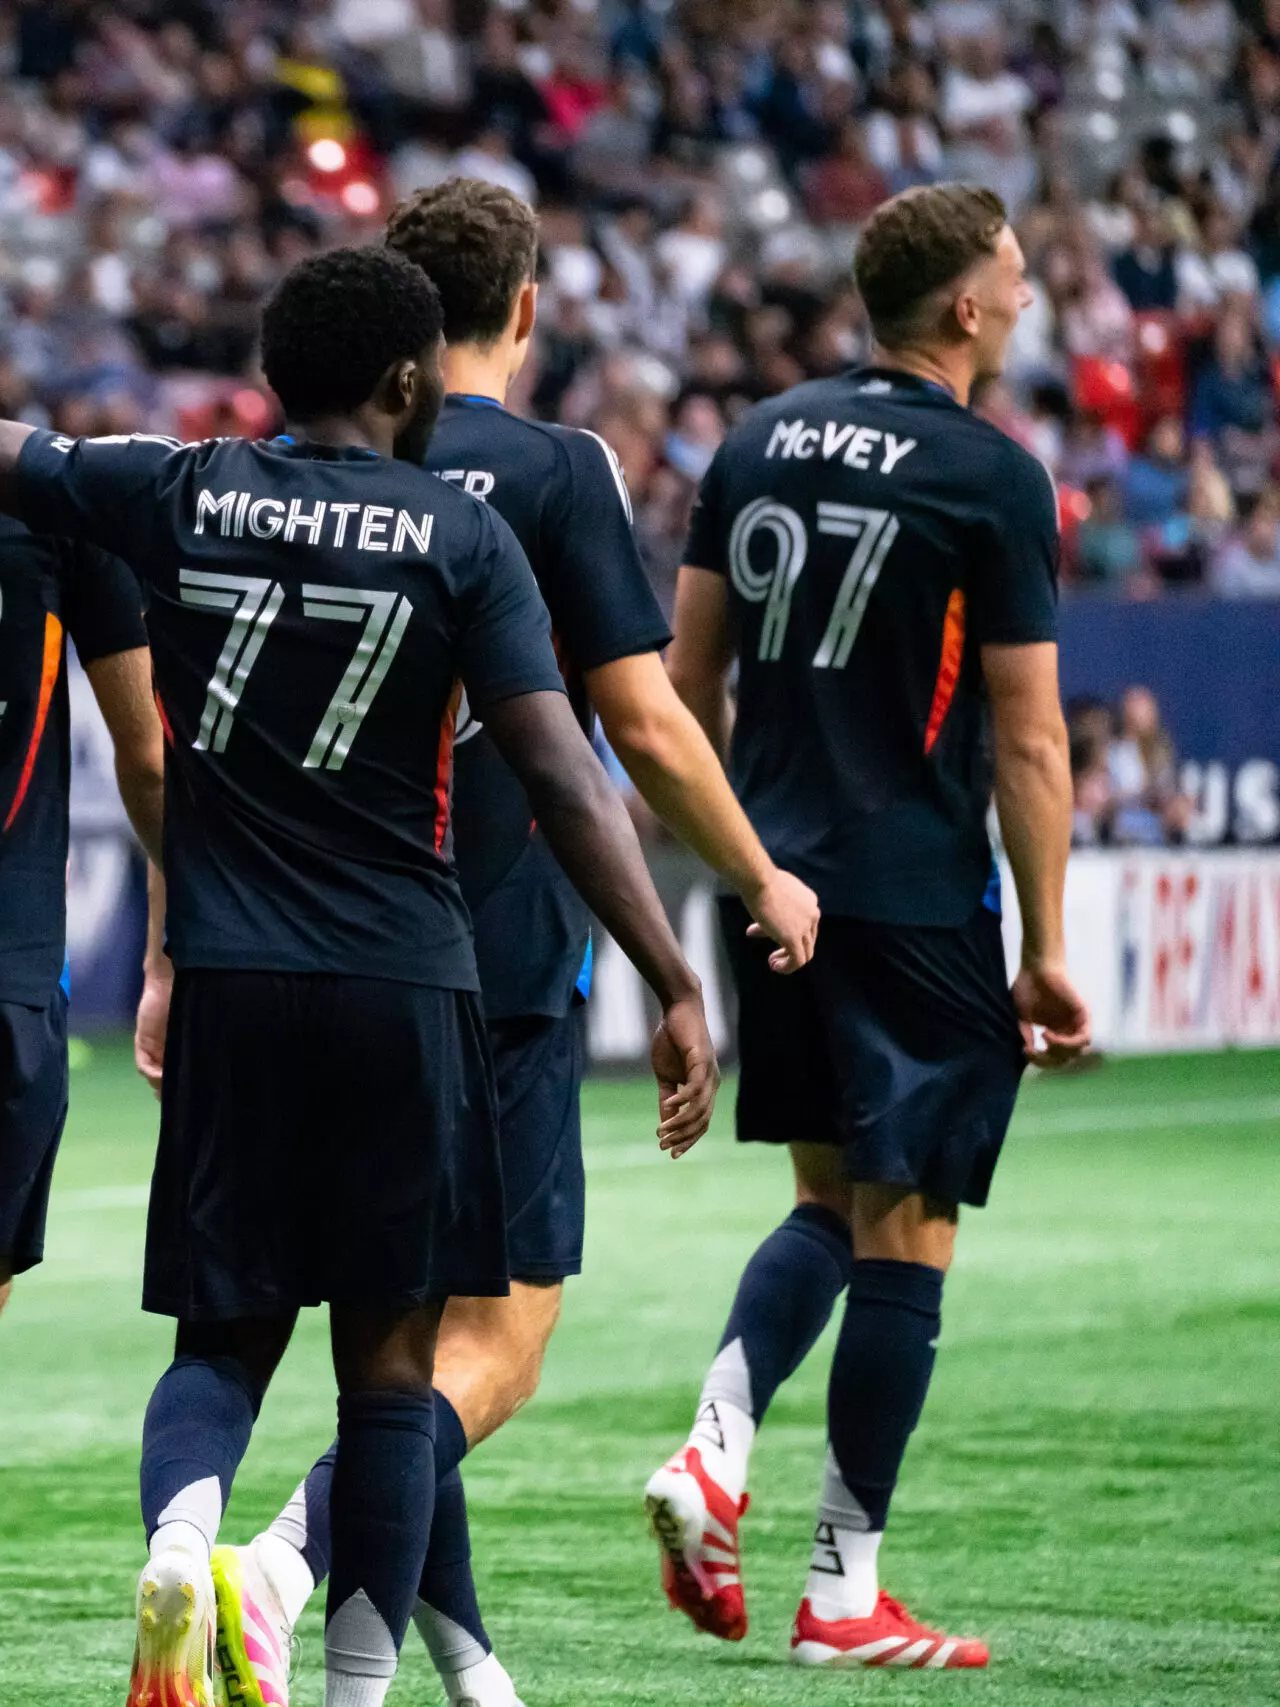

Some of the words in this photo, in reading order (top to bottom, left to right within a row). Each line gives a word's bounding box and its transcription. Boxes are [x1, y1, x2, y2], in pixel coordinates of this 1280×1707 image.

[764, 418, 917, 475] McVEY
[194, 489, 434, 554] MIGHTEN
[729, 497, 900, 670] 97
[178, 568, 414, 771] 77
